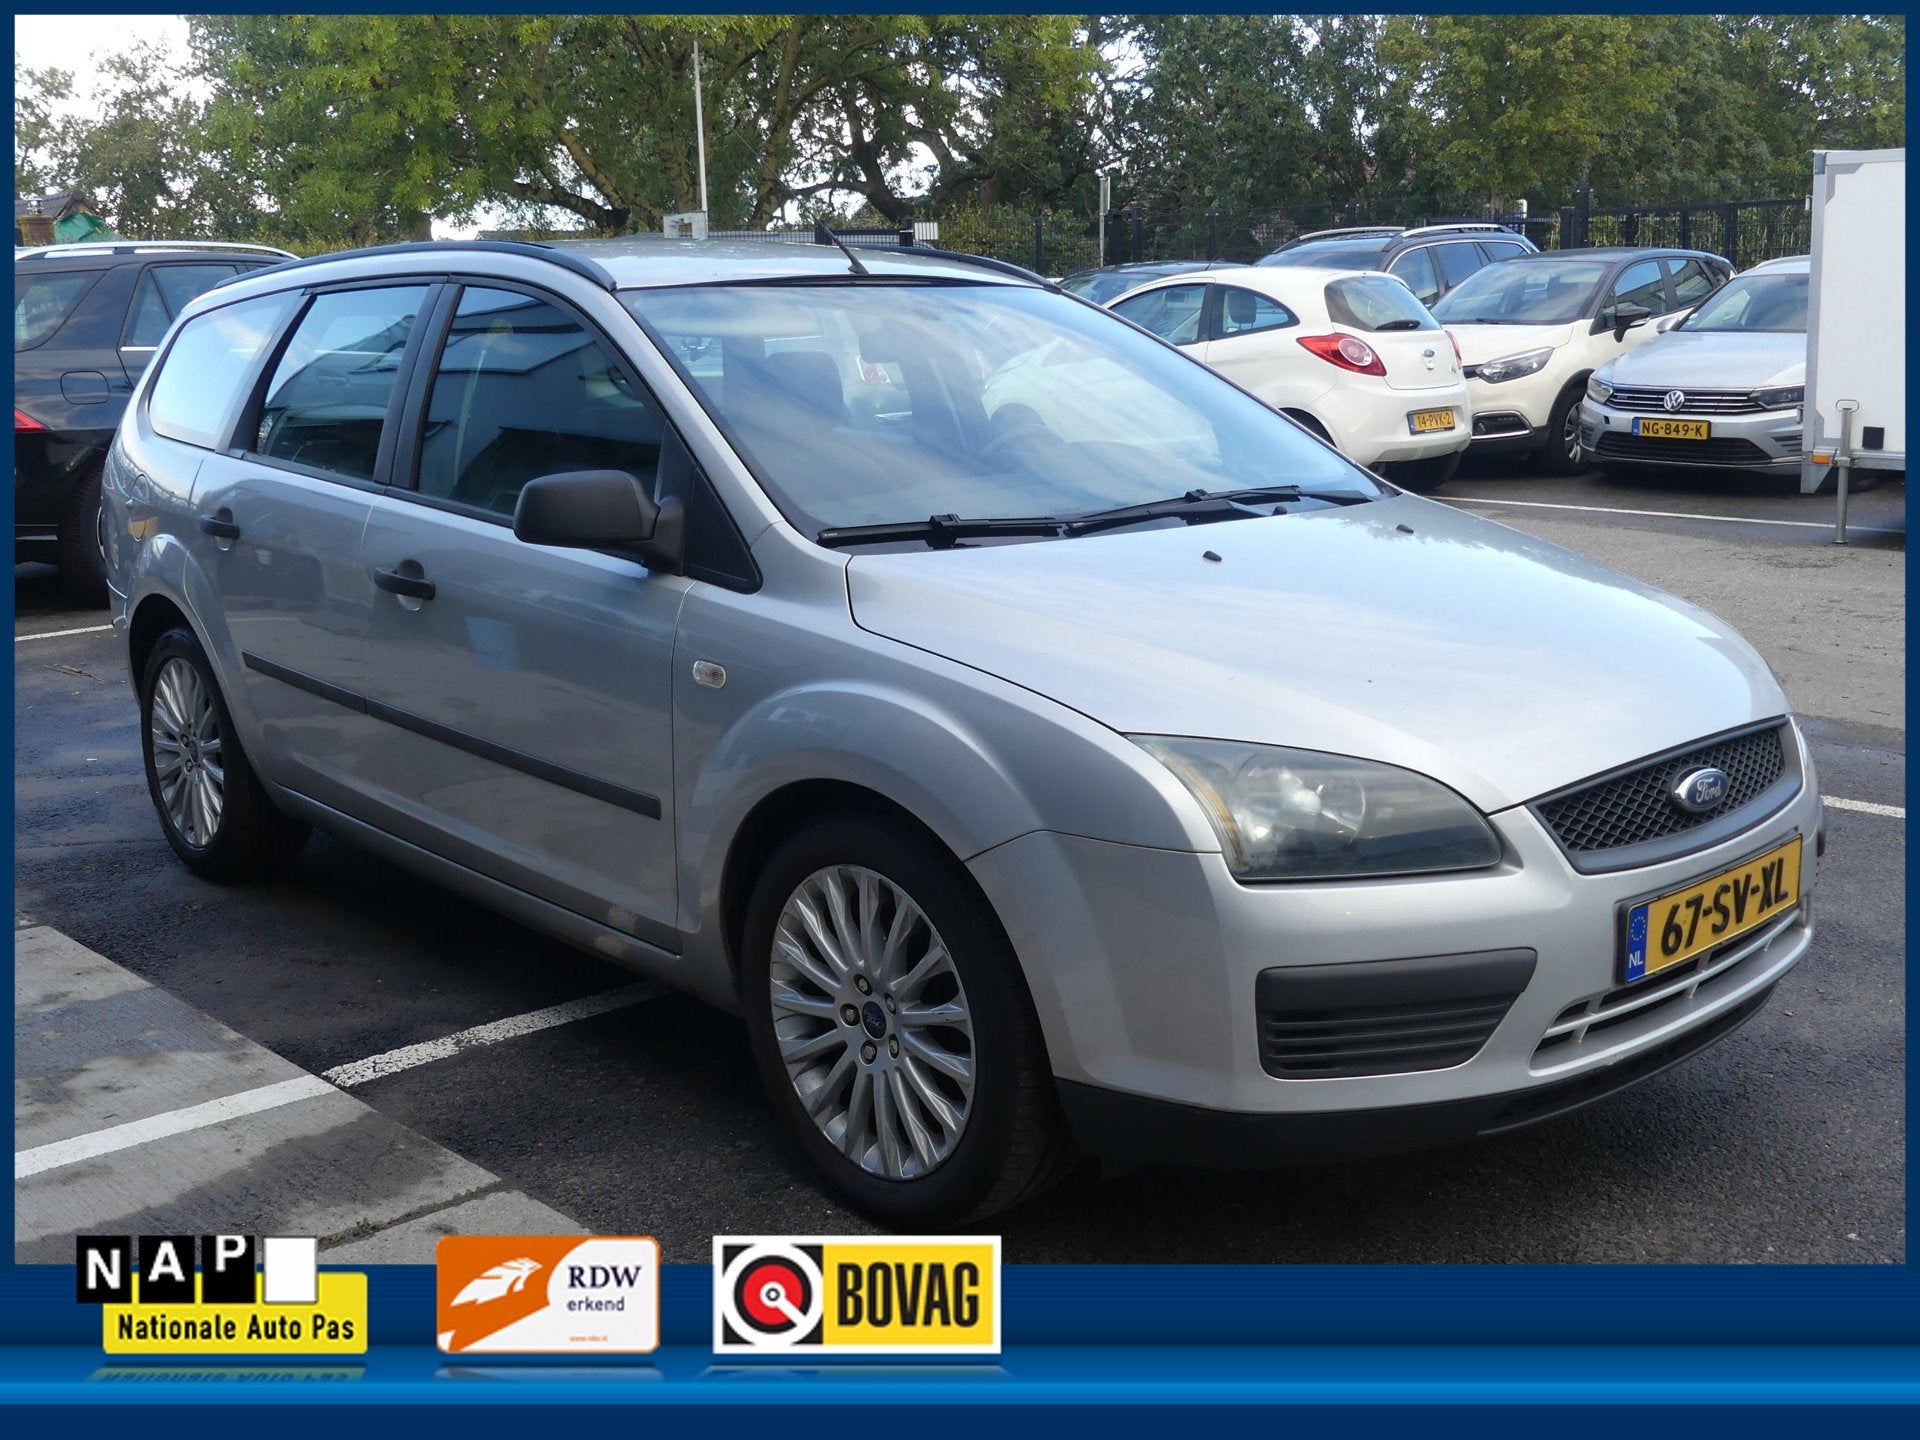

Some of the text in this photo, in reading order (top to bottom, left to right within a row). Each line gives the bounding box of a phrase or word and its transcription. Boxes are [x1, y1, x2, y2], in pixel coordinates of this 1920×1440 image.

[1642, 421, 1703, 437] NG-849-K
[1695, 777, 1722, 803] Ford
[1660, 857, 1789, 956] 67-SV-XL
[1628, 952, 1644, 969] NL
